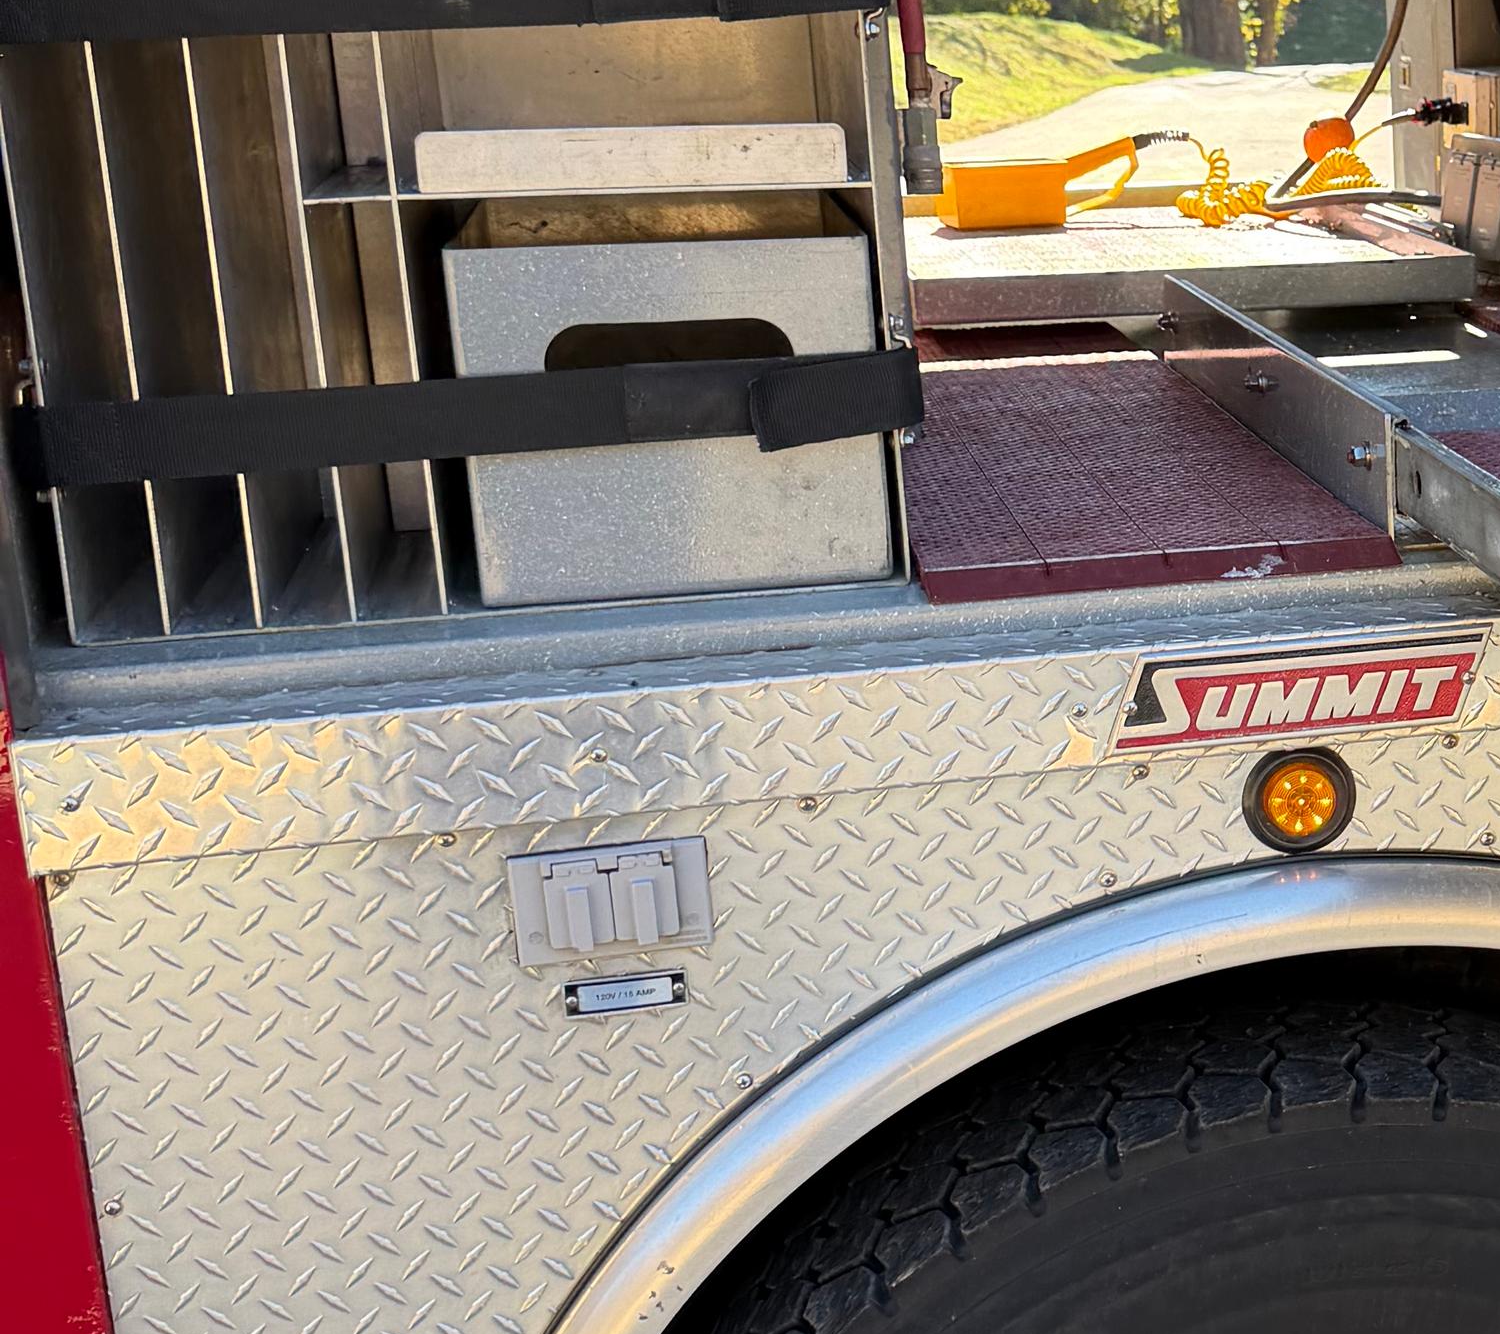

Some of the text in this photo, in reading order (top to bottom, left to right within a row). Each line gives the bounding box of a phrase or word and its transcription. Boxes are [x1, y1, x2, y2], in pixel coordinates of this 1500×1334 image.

[1121, 657, 1460, 740] SUMMIT
[595, 993, 616, 1001] 120V
[636, 987, 657, 997] AMP
